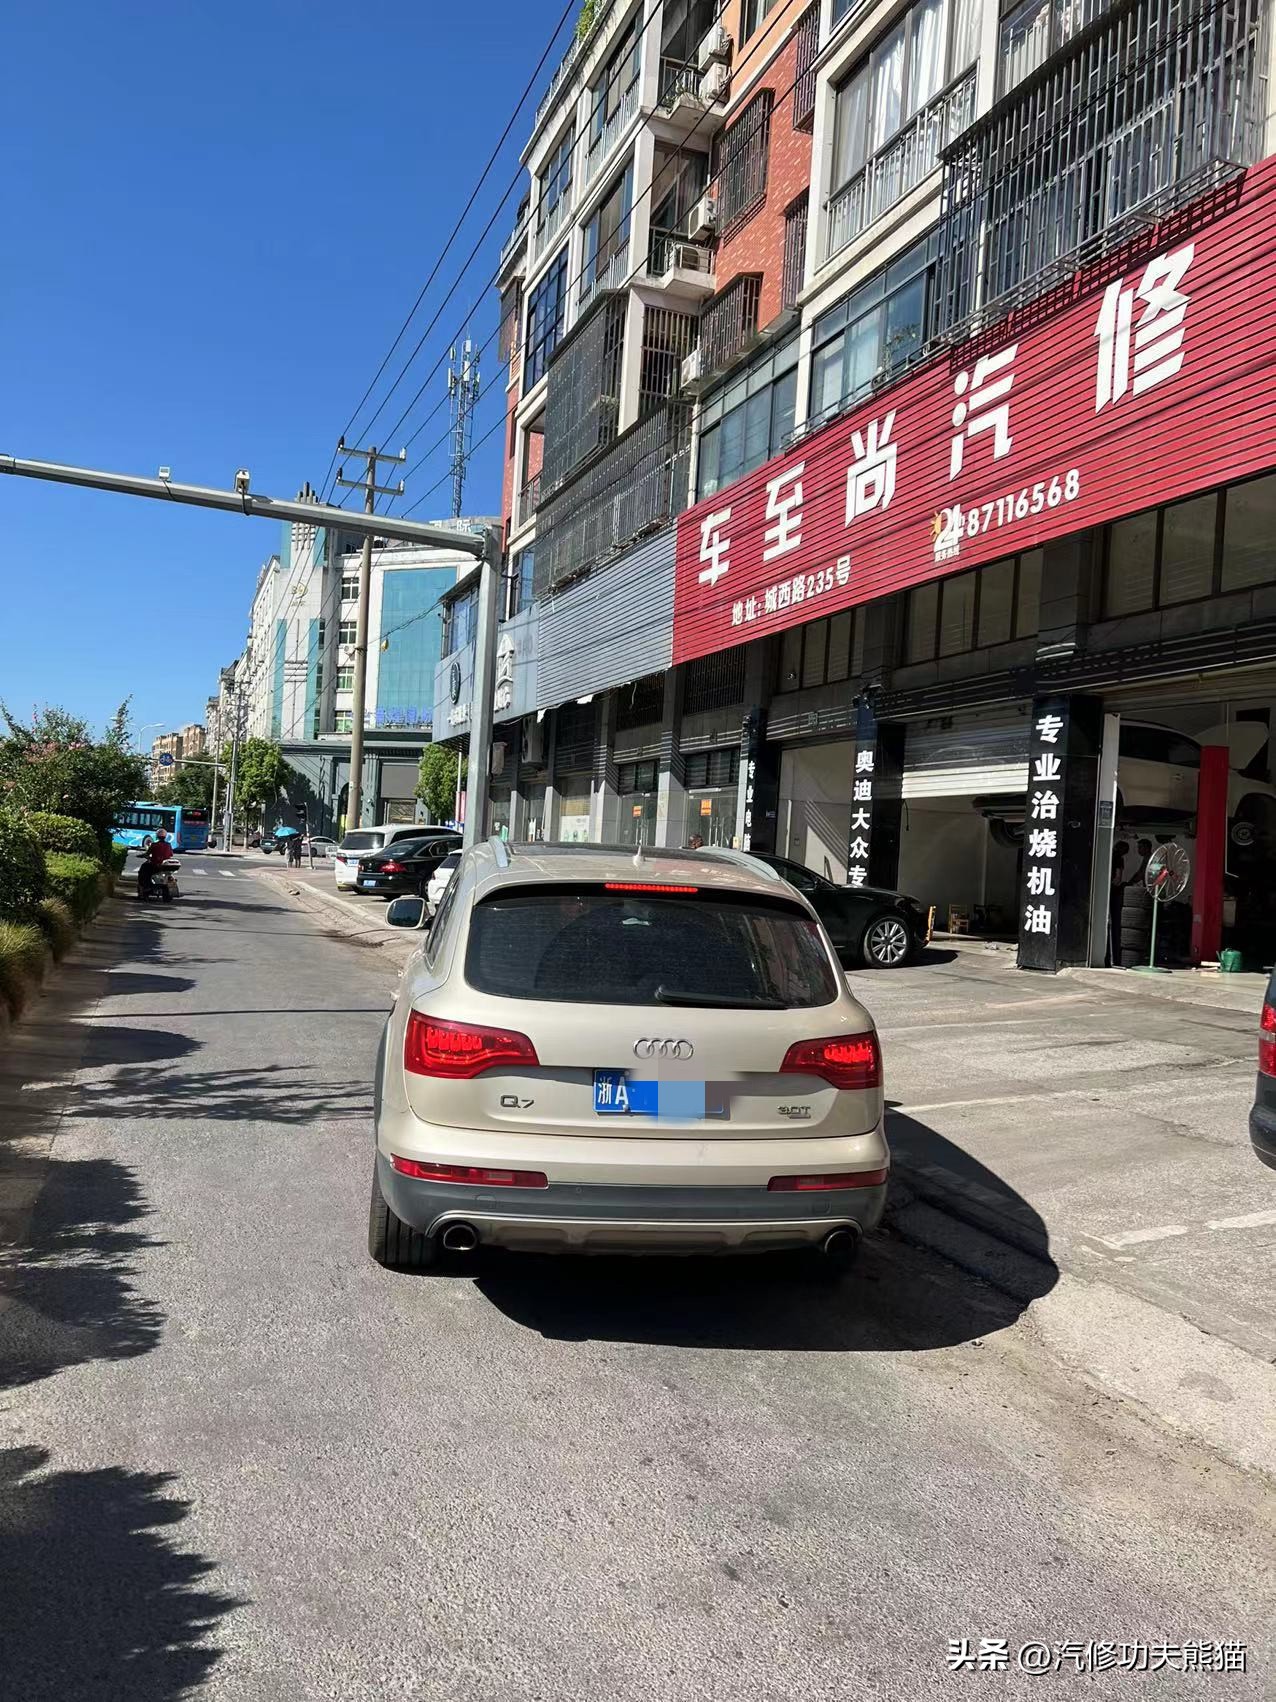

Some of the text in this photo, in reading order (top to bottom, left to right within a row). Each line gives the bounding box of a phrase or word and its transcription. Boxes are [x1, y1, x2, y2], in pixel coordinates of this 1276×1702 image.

[698, 242, 1195, 587] 车至尚汽修
[967, 468, 1080, 537] 87116568
[1024, 714, 1064, 935] 专业治烧机油
[500, 1095, 535, 1108] Q7
